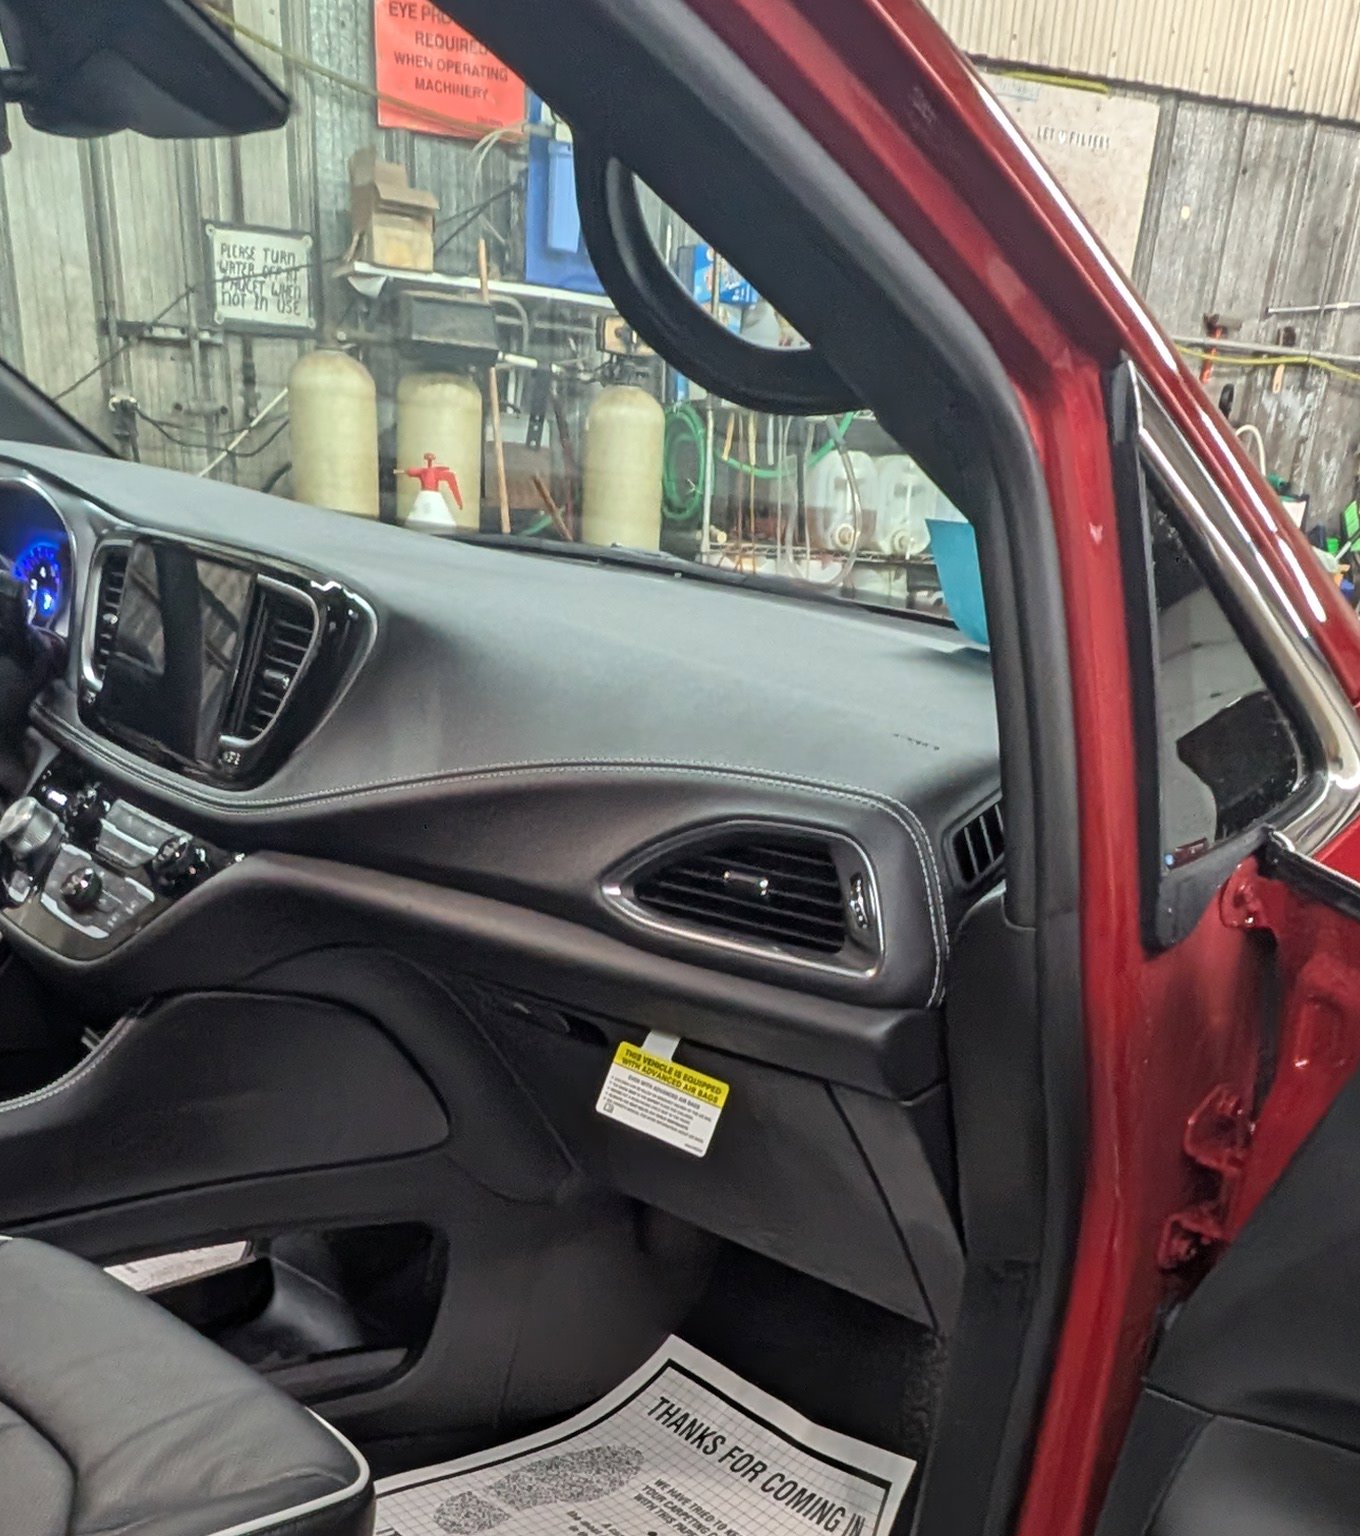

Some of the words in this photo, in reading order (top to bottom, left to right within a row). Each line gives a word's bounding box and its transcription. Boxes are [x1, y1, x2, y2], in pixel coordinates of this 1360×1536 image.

[389, 2, 417, 20] EYE
[415, 31, 488, 55] REQUIRED
[394, 52, 433, 70] WHEN
[437, 59, 508, 82] OPERATING
[415, 77, 489, 100] MACHINERY
[621, 1057, 641, 1070] WITH
[641, 1065, 682, 1087] ADVANCED
[682, 1083, 696, 1093] AIR
[697, 1089, 718, 1103] BAGS
[624, 1049, 641, 1061] THIS
[641, 1056, 674, 1075] VEHICLE
[673, 1069, 682, 1078] IS
[682, 1073, 722, 1095] EQUIPPED
[648, 1397, 727, 1455] THANKS
[718, 1446, 767, 1482] FOR
[760, 1472, 846, 1533] COMING
[634, 1494, 656, 1511] WITH
[655, 1508, 677, 1524] THIS
[642, 1485, 667, 1504] YOUR
[664, 1501, 711, 1535] CARPETING
[654, 1479, 670, 1490] WE
[668, 1488, 688, 1506] HAVE
[689, 1503, 714, 1521] TRIED
[714, 1520, 727, 1531] TO
